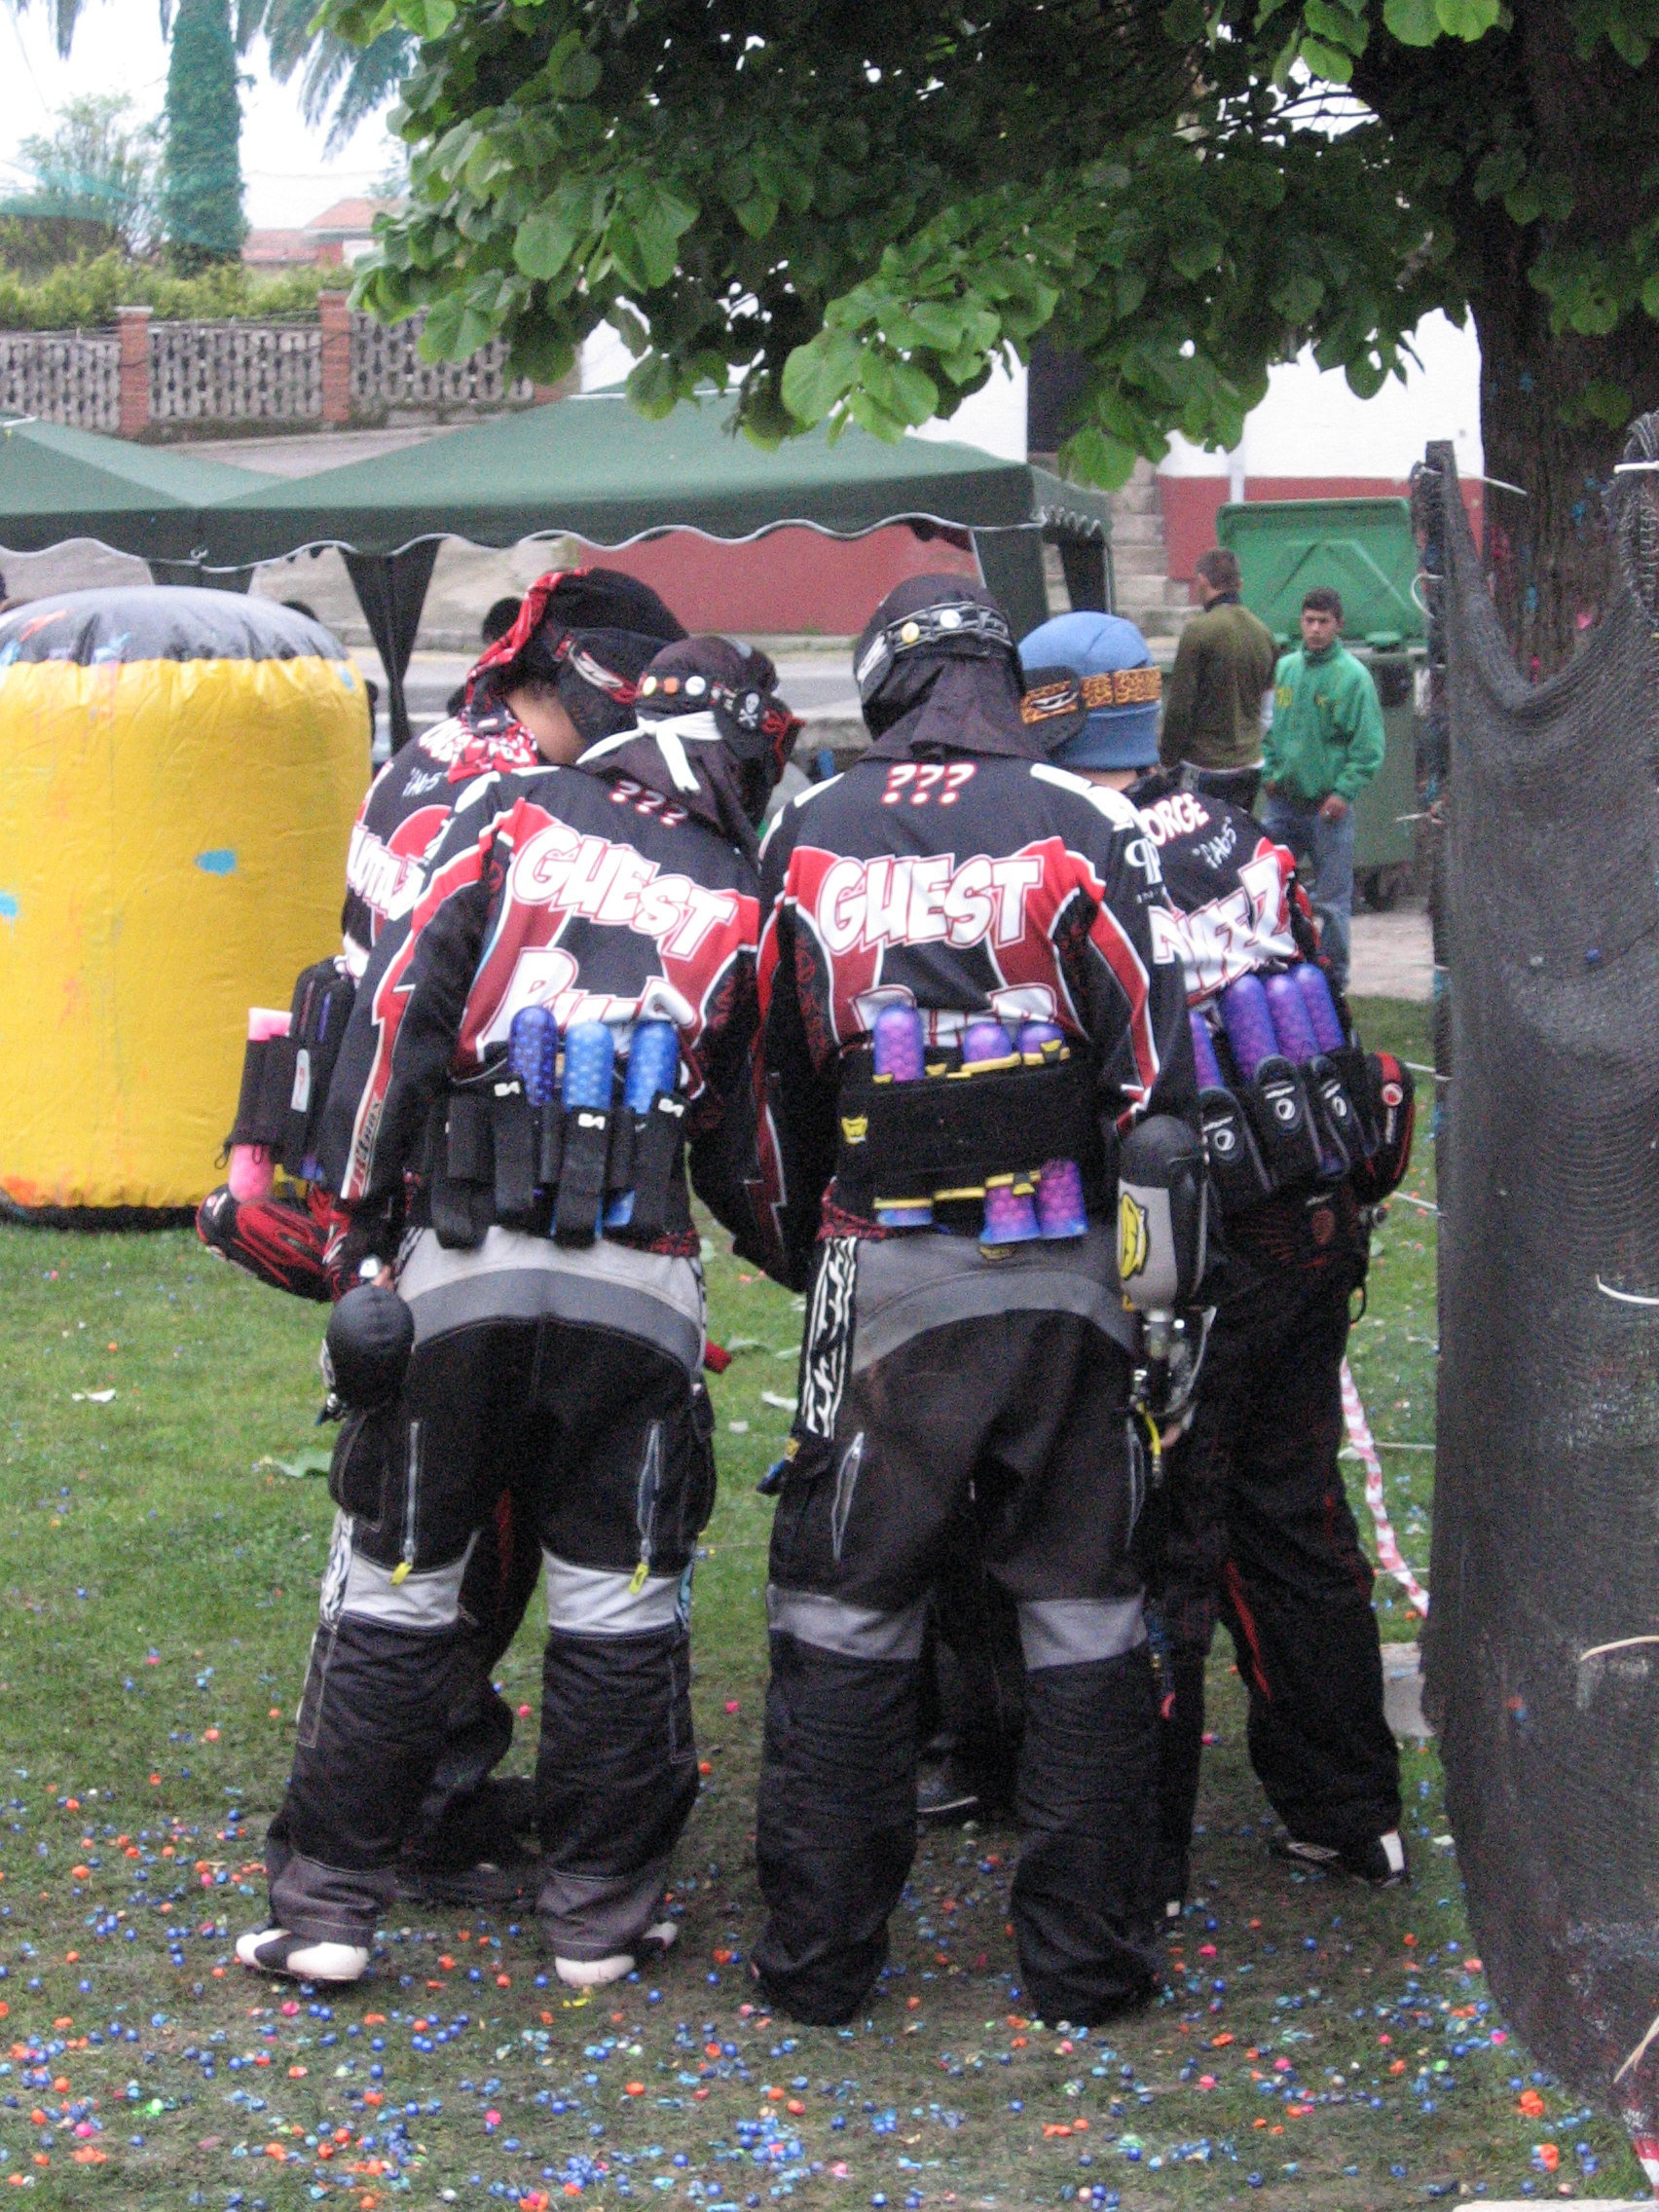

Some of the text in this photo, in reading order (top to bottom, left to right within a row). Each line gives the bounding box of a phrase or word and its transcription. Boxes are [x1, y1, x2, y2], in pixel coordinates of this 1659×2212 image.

[1141, 793, 1210, 846] ORGE
[512, 824, 738, 962] GUEST
[816, 853, 1045, 956] GUEST
